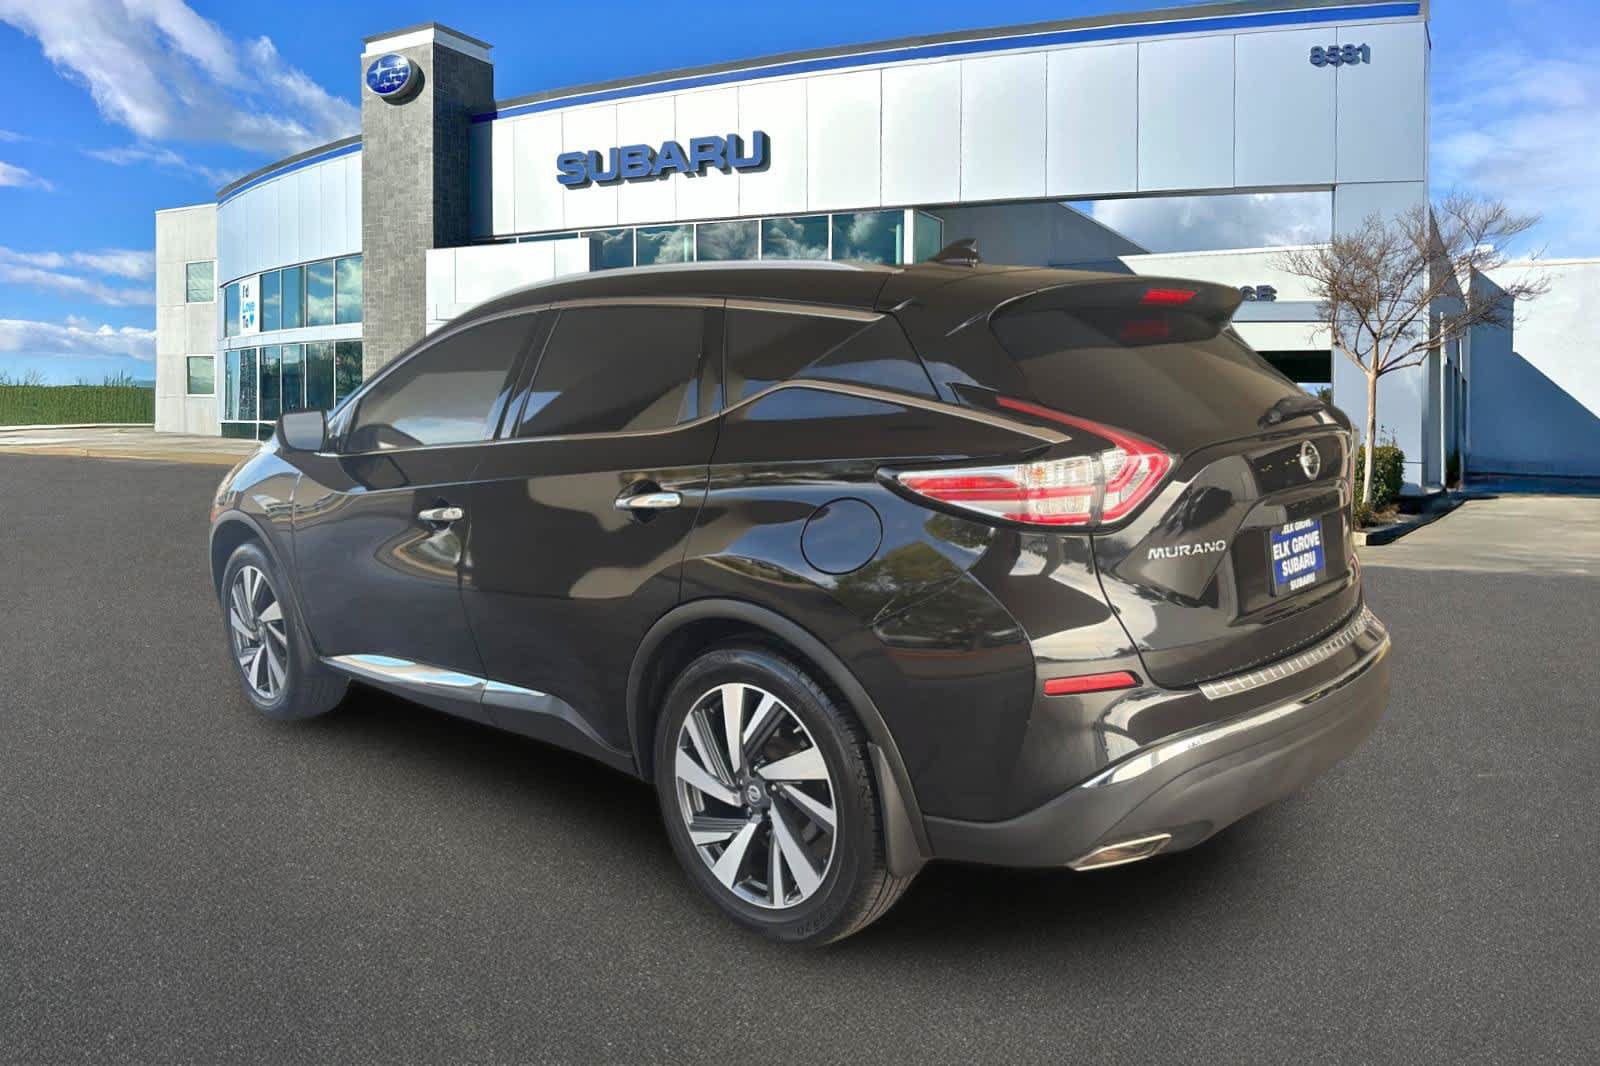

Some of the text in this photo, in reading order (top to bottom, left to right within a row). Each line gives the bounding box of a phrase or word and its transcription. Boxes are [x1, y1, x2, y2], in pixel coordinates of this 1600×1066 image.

[556, 130, 771, 190] SUBARU
[1148, 540, 1226, 560] MURANO
[1273, 530, 1320, 561] ELK GROVE
[1282, 550, 1316, 577] SUBARU
[1290, 572, 1316, 591] SUBARU
